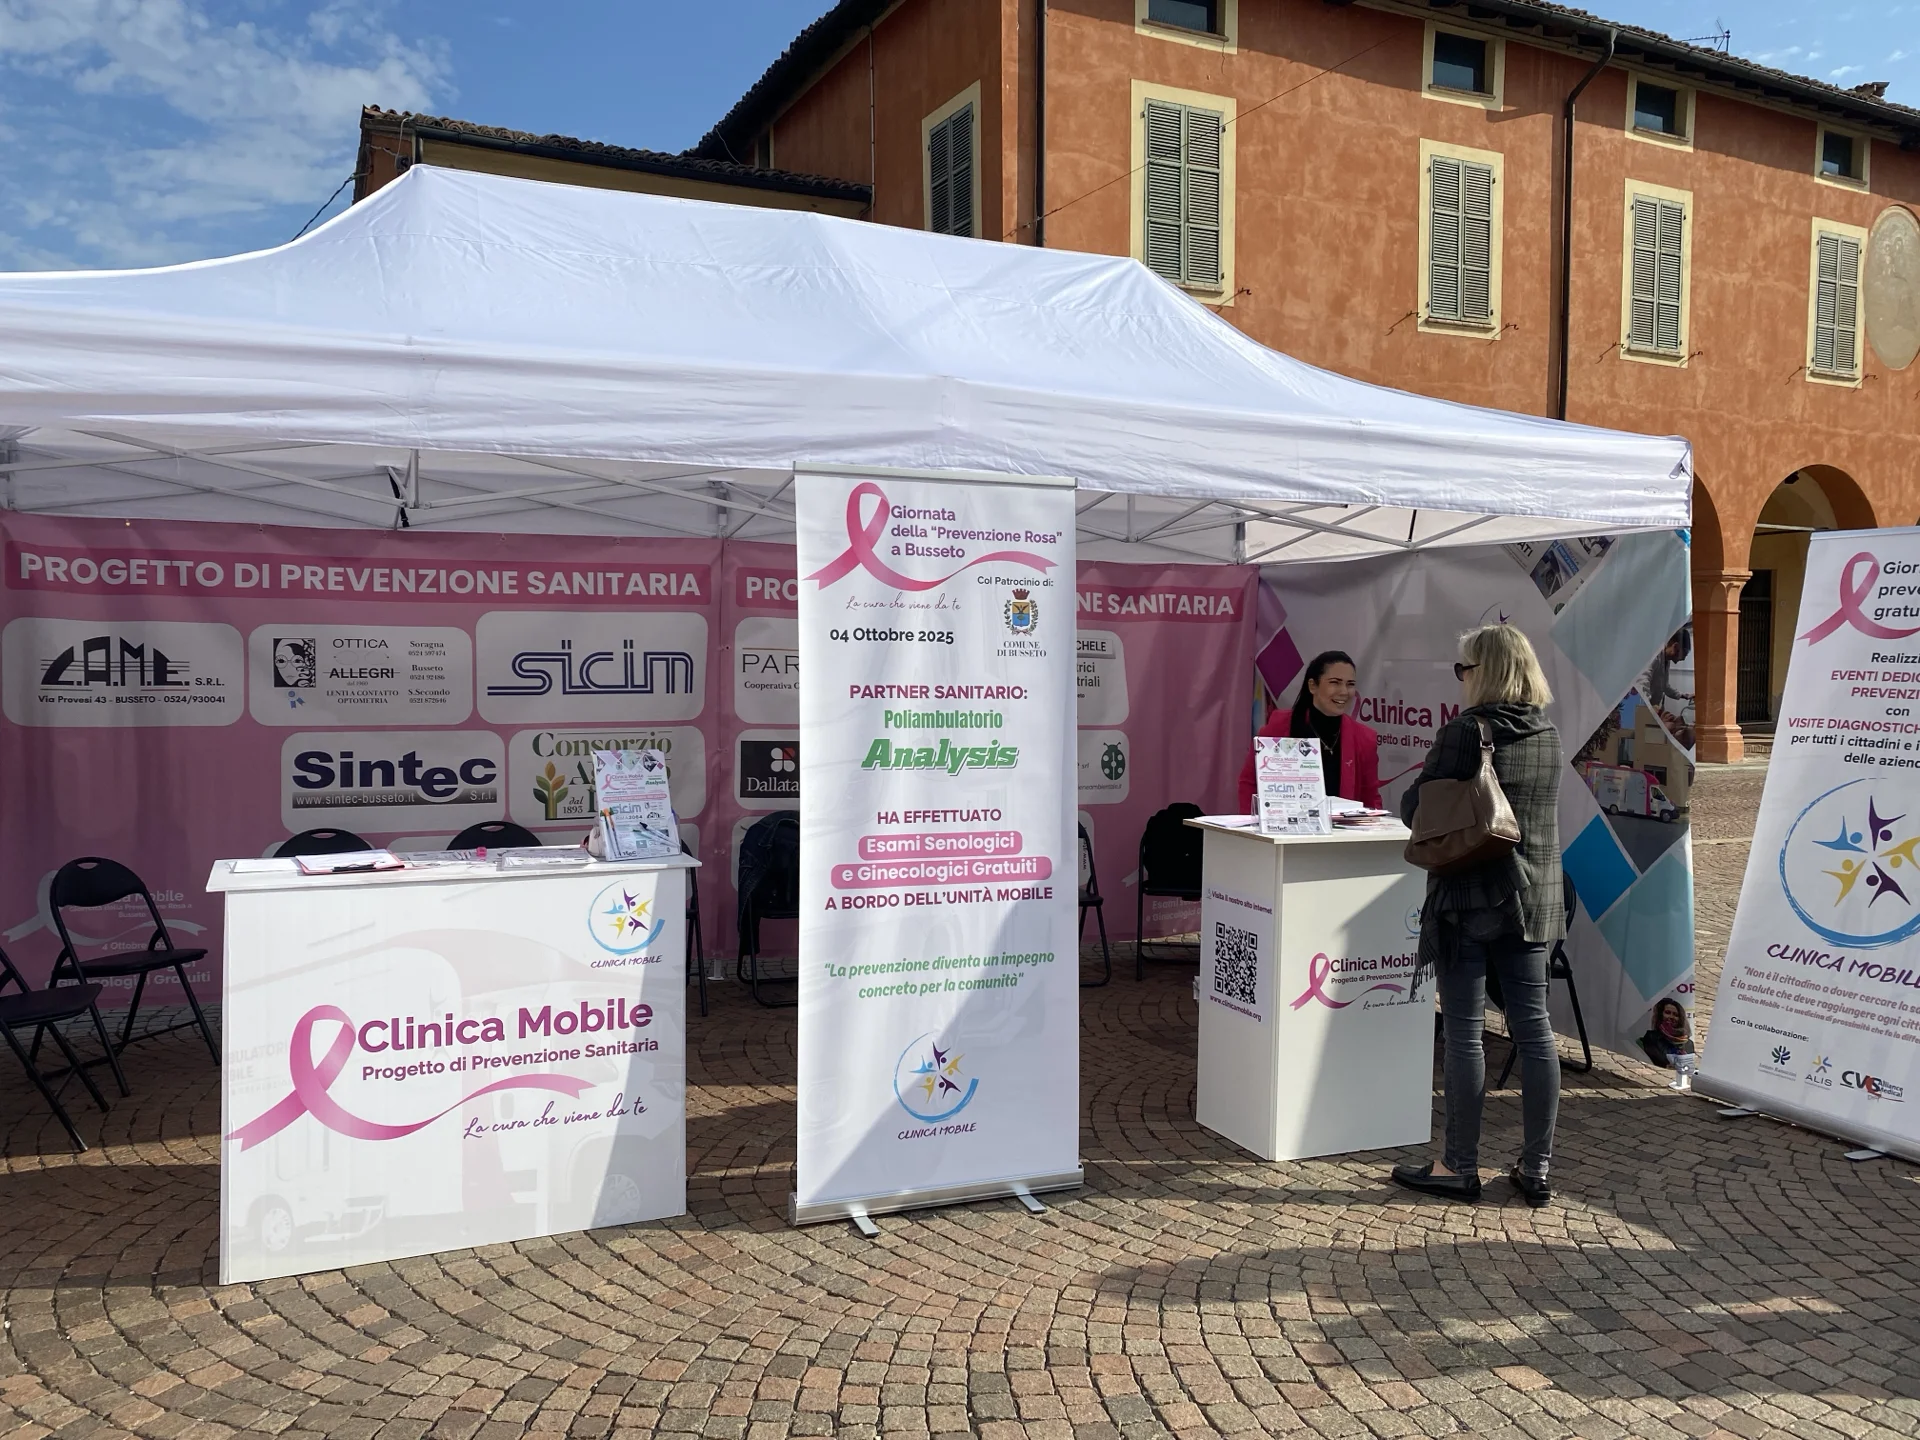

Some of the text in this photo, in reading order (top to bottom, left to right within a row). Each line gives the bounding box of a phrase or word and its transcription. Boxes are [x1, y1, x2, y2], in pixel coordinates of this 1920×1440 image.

[890, 506, 956, 521] Giornata
[891, 525, 928, 538] della
[891, 543, 965, 559] a Busseto
[20, 552, 701, 596] PROGETTO DI PREVENZIONE SANITARIA
[977, 576, 1054, 587] Col Patrocinio di:
[846, 592, 961, 610] La cura che viene da te
[1108, 594, 1234, 616] SANITARIA
[333, 638, 389, 649] OTTICA
[829, 627, 954, 645] 04 Ottobre 2025
[410, 640, 444, 649] Soragna
[1003, 640, 1040, 649] COMUNE
[997, 649, 1047, 657] DI BUSSETO
[412, 664, 443, 672] Busseto
[487, 639, 693, 696] sicim
[742, 654, 799, 674] PAR
[329, 668, 394, 679] ALLEGRI
[1831, 670, 1878, 681] EVENTI
[195, 677, 225, 687] S.R.L.
[744, 681, 792, 691] Cooperativa
[38, 695, 225, 704] Via Provesi 43 BUSSETO 0524/930041
[408, 688, 450, 696] S.Secondo
[849, 685, 1028, 700] PARTNER SANITARIO:
[884, 709, 1003, 729] Poliambulatorio
[1360, 698, 1433, 728] Clinica
[1885, 707, 1910, 716] con
[1788, 718, 1824, 728] VISITE
[532, 732, 672, 757] Consorzio
[1400, 735, 1410, 746] di
[1791, 734, 1912, 751] per tutti i cittadini e
[861, 738, 1019, 776] Analysis
[1844, 752, 1875, 765] delle
[292, 750, 497, 798] Sintec
[296, 790, 494, 805] www.sintec-busseto.it S.r.l.
[569, 796, 584, 805] dal
[563, 806, 583, 814] 1893
[877, 808, 1002, 825] HA EFFETTUATO
[866, 832, 1015, 853] Esami Senologici
[841, 858, 1037, 882] e Ginecologici Gratuiti
[825, 897, 837, 910] A
[842, 894, 900, 909] BORDO
[997, 887, 1053, 901] MOBILE
[590, 954, 663, 968] CLINICA MOBILE
[848, 958, 930, 979] prevenzione
[932, 954, 981, 970] diventa
[983, 954, 999, 967] un
[1001, 951, 1055, 968] impegno
[1330, 957, 1377, 973] Clinica
[1767, 944, 1845, 972] CLINICA
[1331, 976, 1358, 985] Progetto
[1366, 973, 1401, 981] Prevenzione
[858, 984, 918, 999] concreto
[919, 982, 942, 997] per
[943, 979, 956, 992] la
[1766, 971, 1772, 980] è
[1772, 972, 1779, 982] il
[1779, 974, 1821, 992] cittadino
[1830, 986, 1859, 1000] dover
[1859, 994, 1897, 1009] cercare
[1898, 1001, 1909, 1011] la
[1730, 976, 1901, 1026] È la salute che deve raggiungere ogni
[1737, 994, 1759, 1004] Clinica
[1759, 999, 1780, 1009] Mobile
[1794, 1008, 1825, 1020] medicina
[1825, 1014, 1832, 1022] di
[358, 998, 653, 1053] Clinica Mobile
[1730, 1016, 1809, 1042] Con la collaborazione:
[362, 1038, 659, 1082] Progetto di Prevenzione Sanitaria
[1805, 1074, 1832, 1086] ALIS
[1878, 1080, 1904, 1091] Alliance
[463, 1092, 648, 1140] La cura che viene da te
[897, 1123, 977, 1140] CLINICA MOBILE
